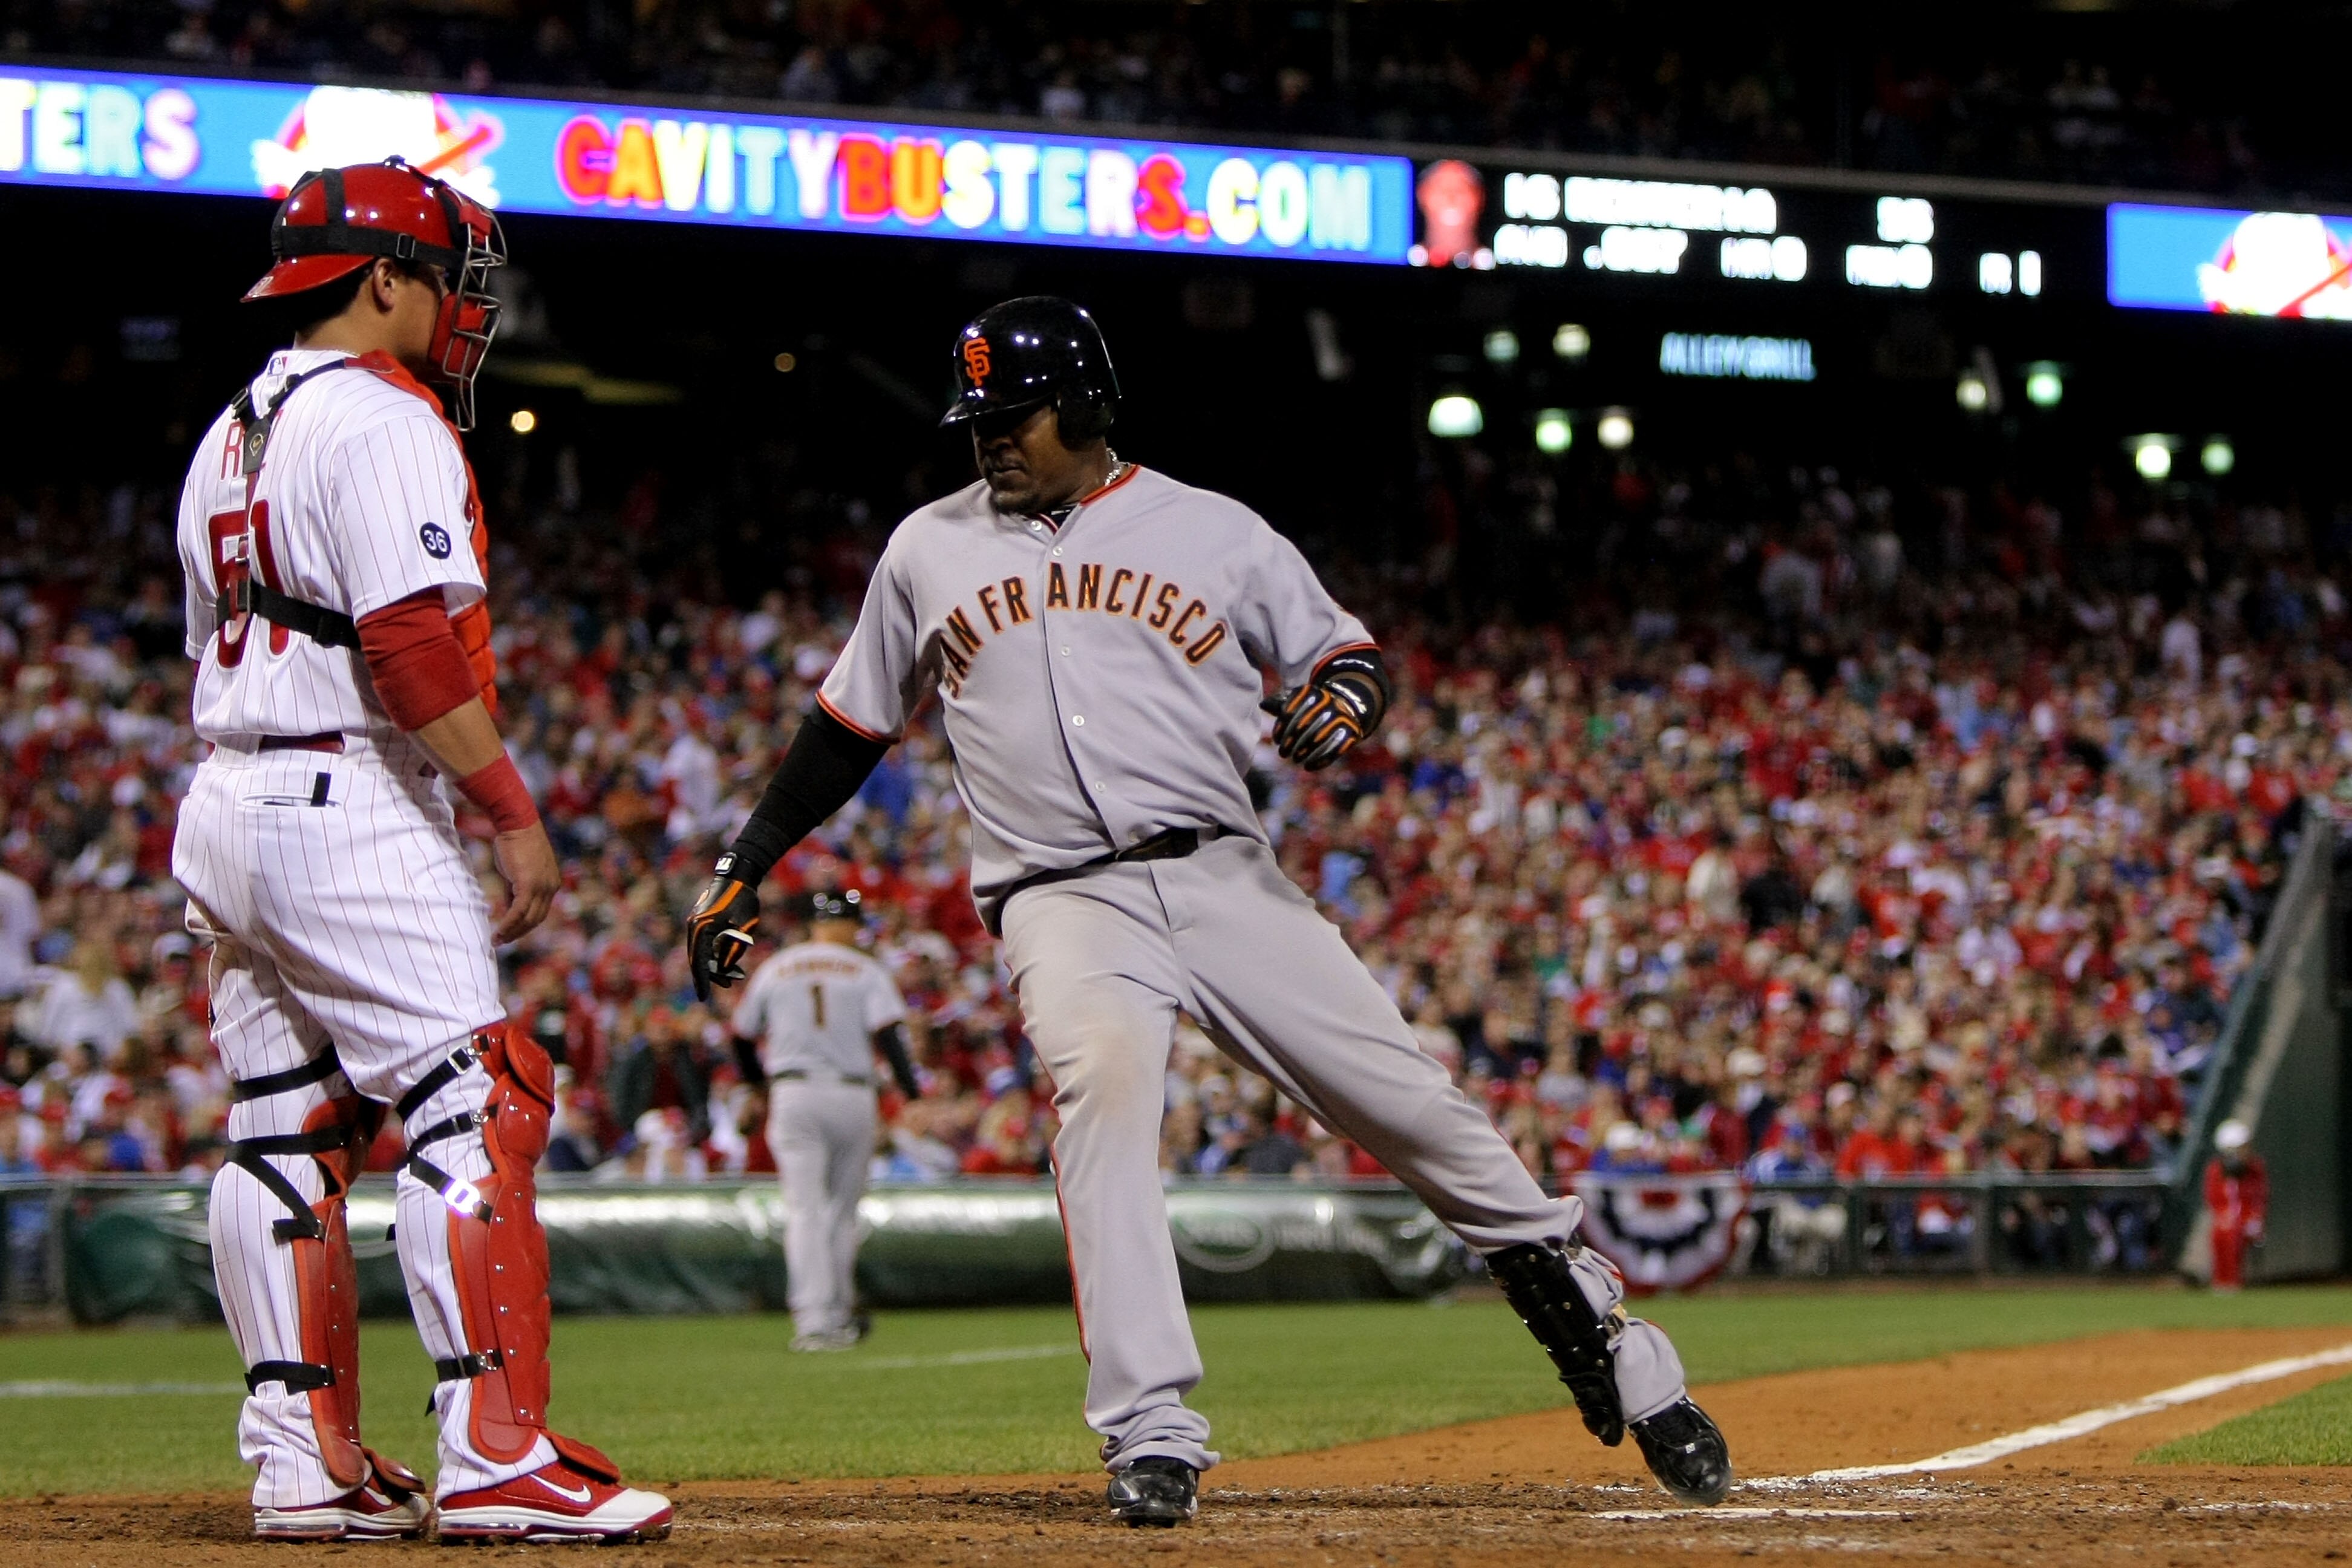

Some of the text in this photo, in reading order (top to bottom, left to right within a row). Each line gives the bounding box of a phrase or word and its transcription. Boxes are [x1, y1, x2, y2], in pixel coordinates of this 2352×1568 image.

[555, 115, 1371, 250] CAVITYBUSTERS.COM
[424, 529, 448, 553] 36
[977, 561, 1228, 667] FRANCISCO
[809, 982, 826, 1028] 1
